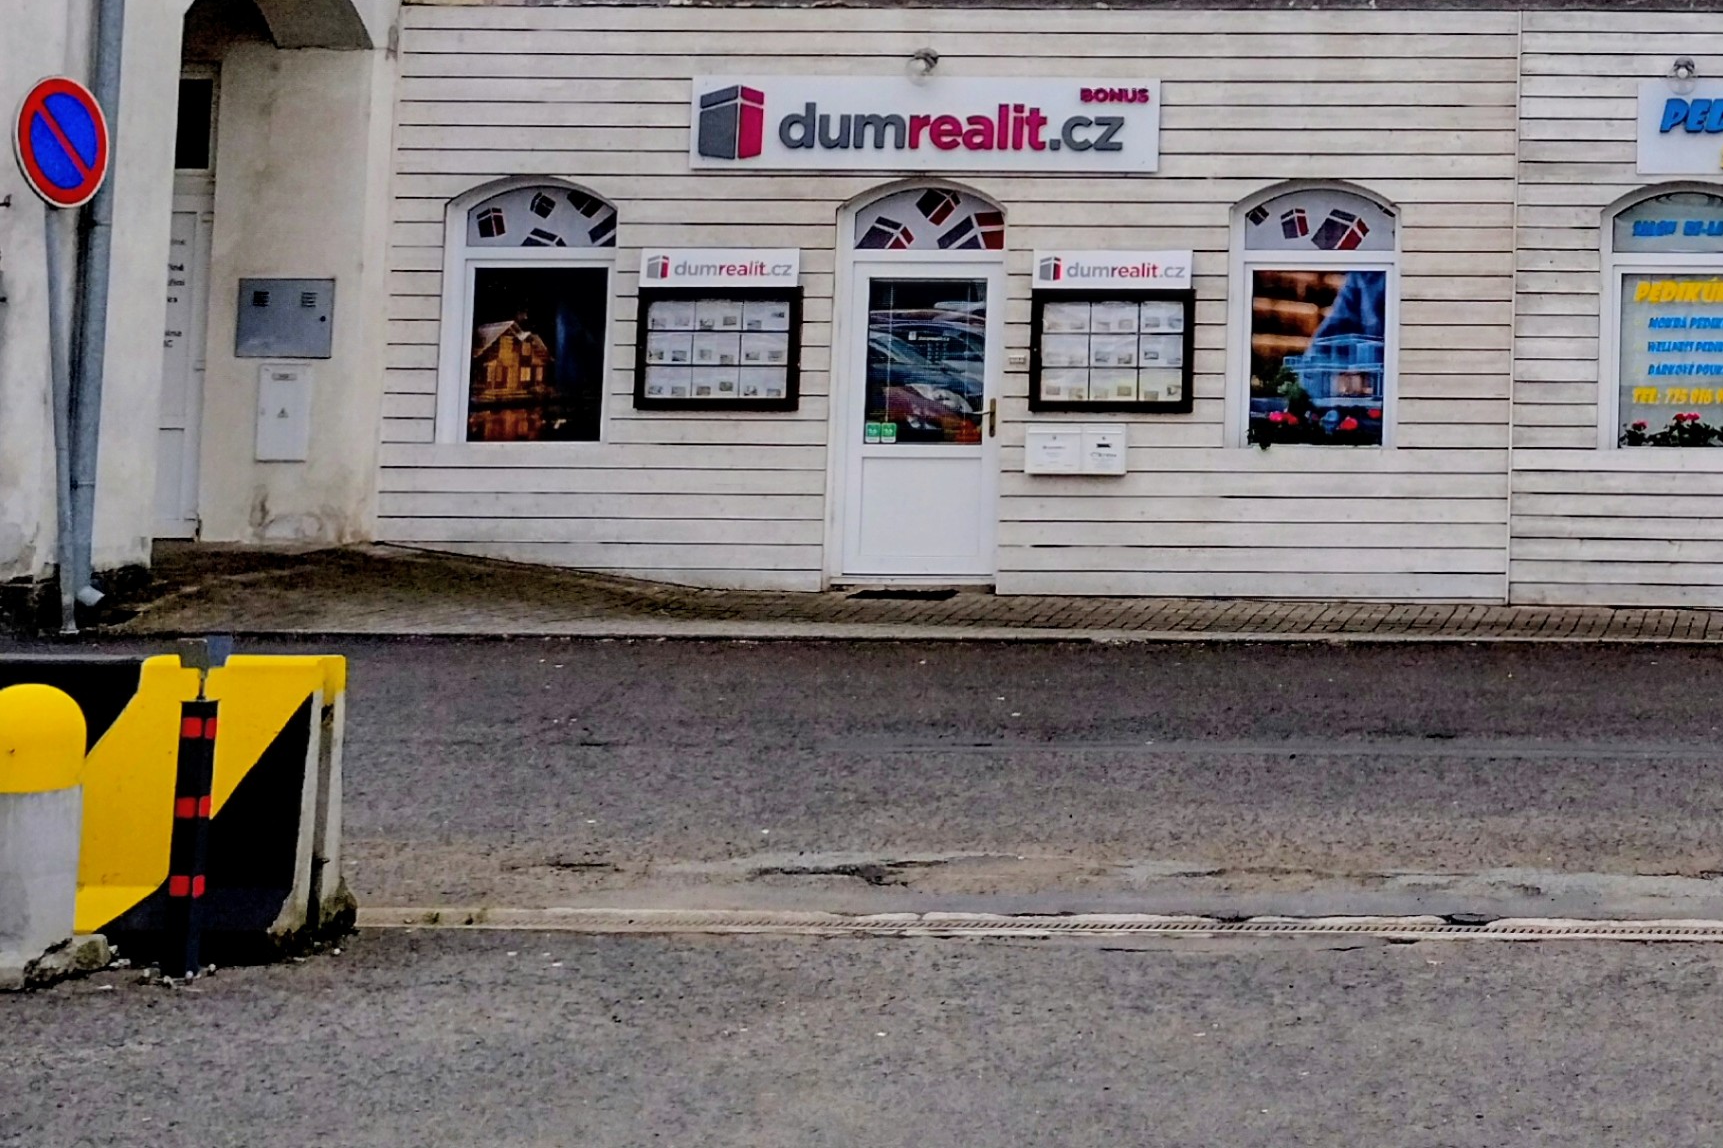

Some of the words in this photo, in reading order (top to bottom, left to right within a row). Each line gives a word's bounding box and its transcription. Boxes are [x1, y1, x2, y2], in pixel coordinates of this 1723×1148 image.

[1080, 87, 1149, 103] BONUS
[778, 102, 1125, 151] dumrealit.cz
[674, 255, 793, 277] dumrealit.cz
[1066, 262, 1185, 279] dumrealit.cz
